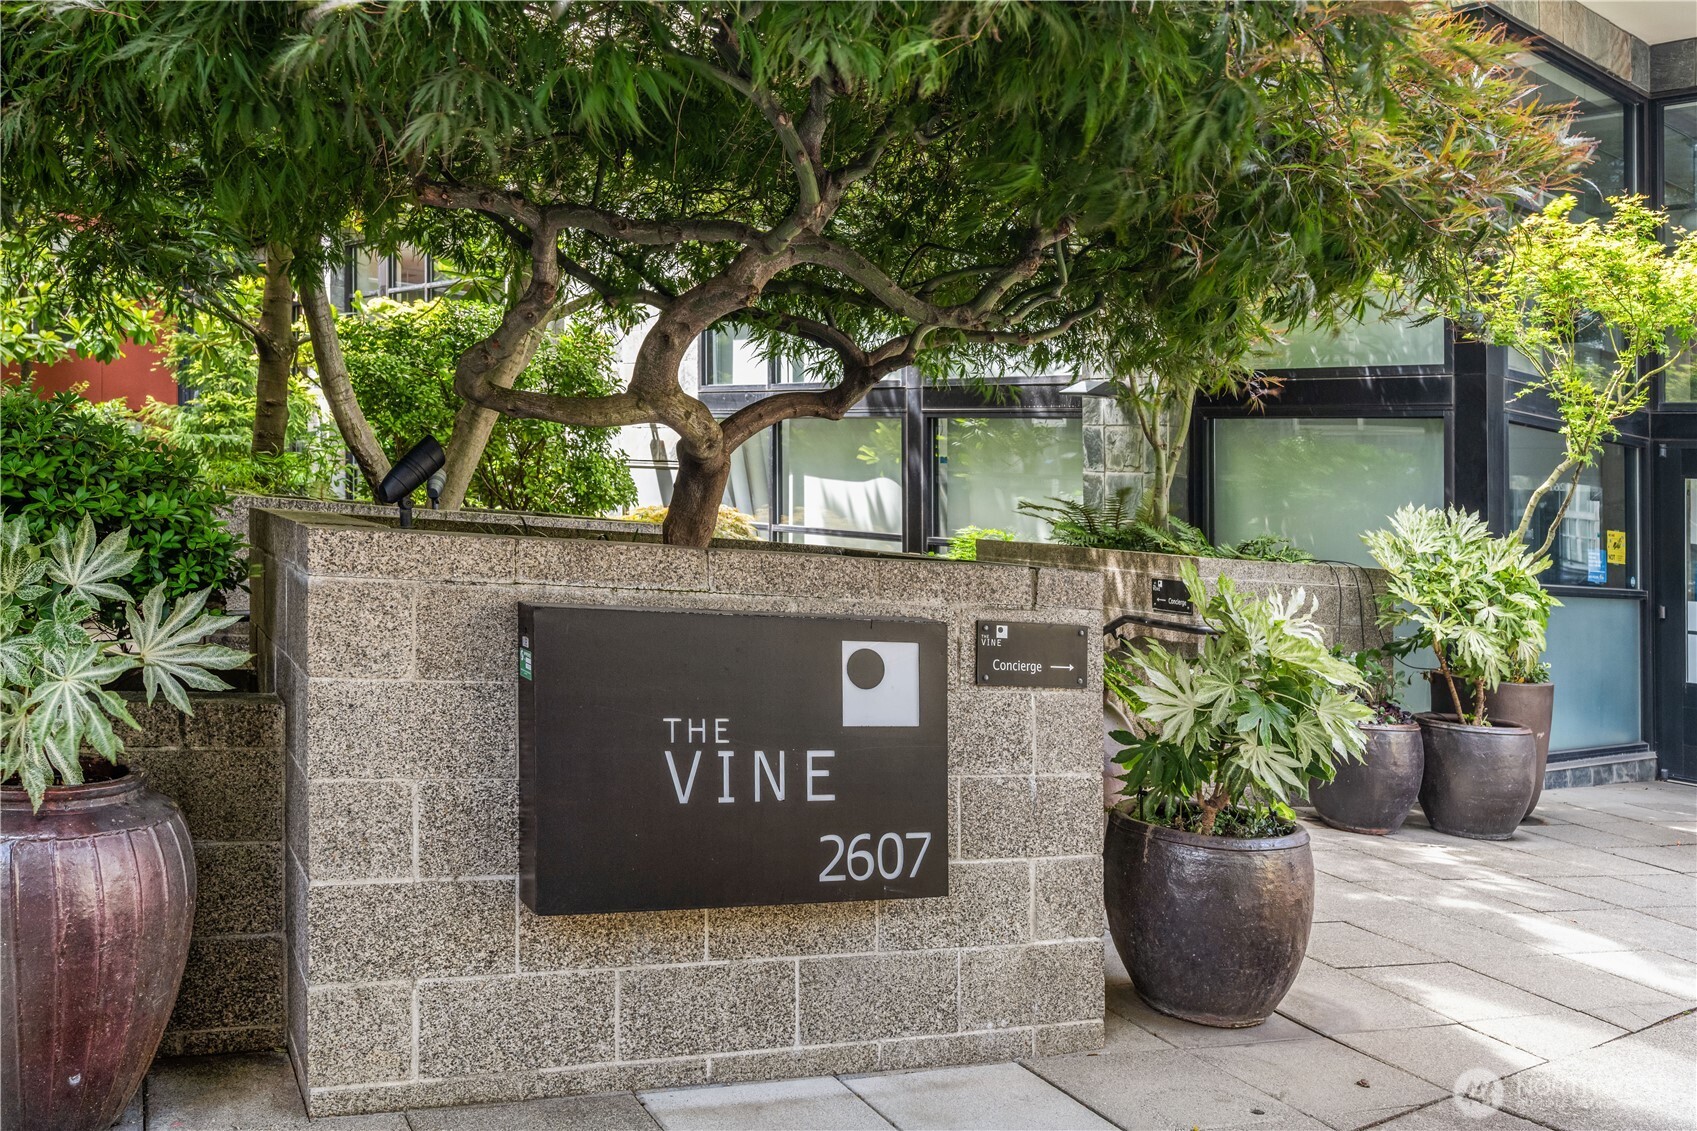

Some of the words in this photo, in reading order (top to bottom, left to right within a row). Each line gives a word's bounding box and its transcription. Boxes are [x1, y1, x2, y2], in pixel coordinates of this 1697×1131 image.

[993, 659, 1042, 674] Concierge
[663, 718, 729, 743] THE
[665, 750, 835, 803] VINE
[819, 832, 931, 882] 2607
